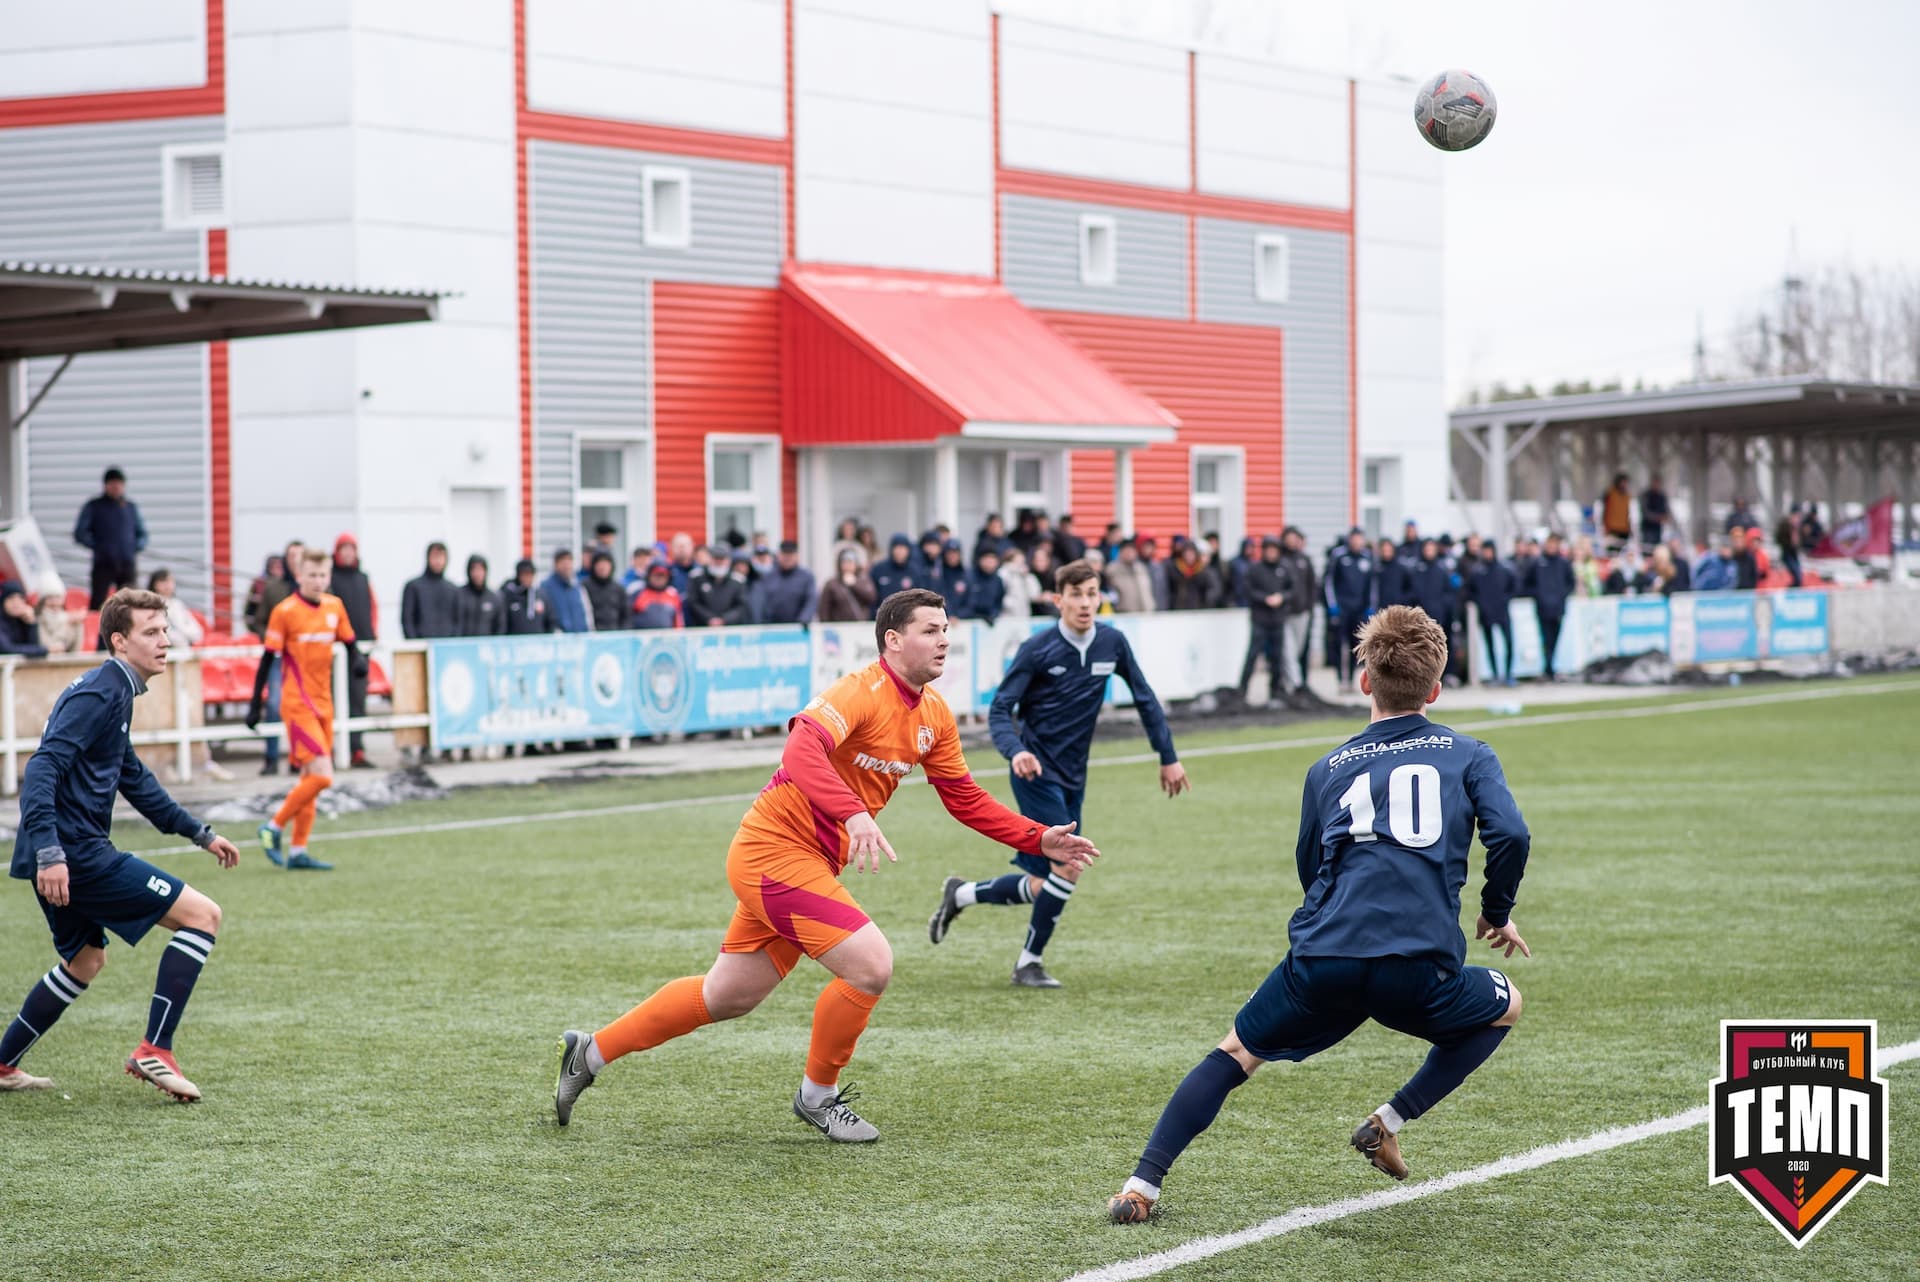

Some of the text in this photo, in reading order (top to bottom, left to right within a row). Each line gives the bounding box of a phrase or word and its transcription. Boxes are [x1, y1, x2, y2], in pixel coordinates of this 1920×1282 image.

[1338, 763, 1443, 848] 10
[146, 875, 172, 898] 5
[1487, 969, 1508, 1001] 10
